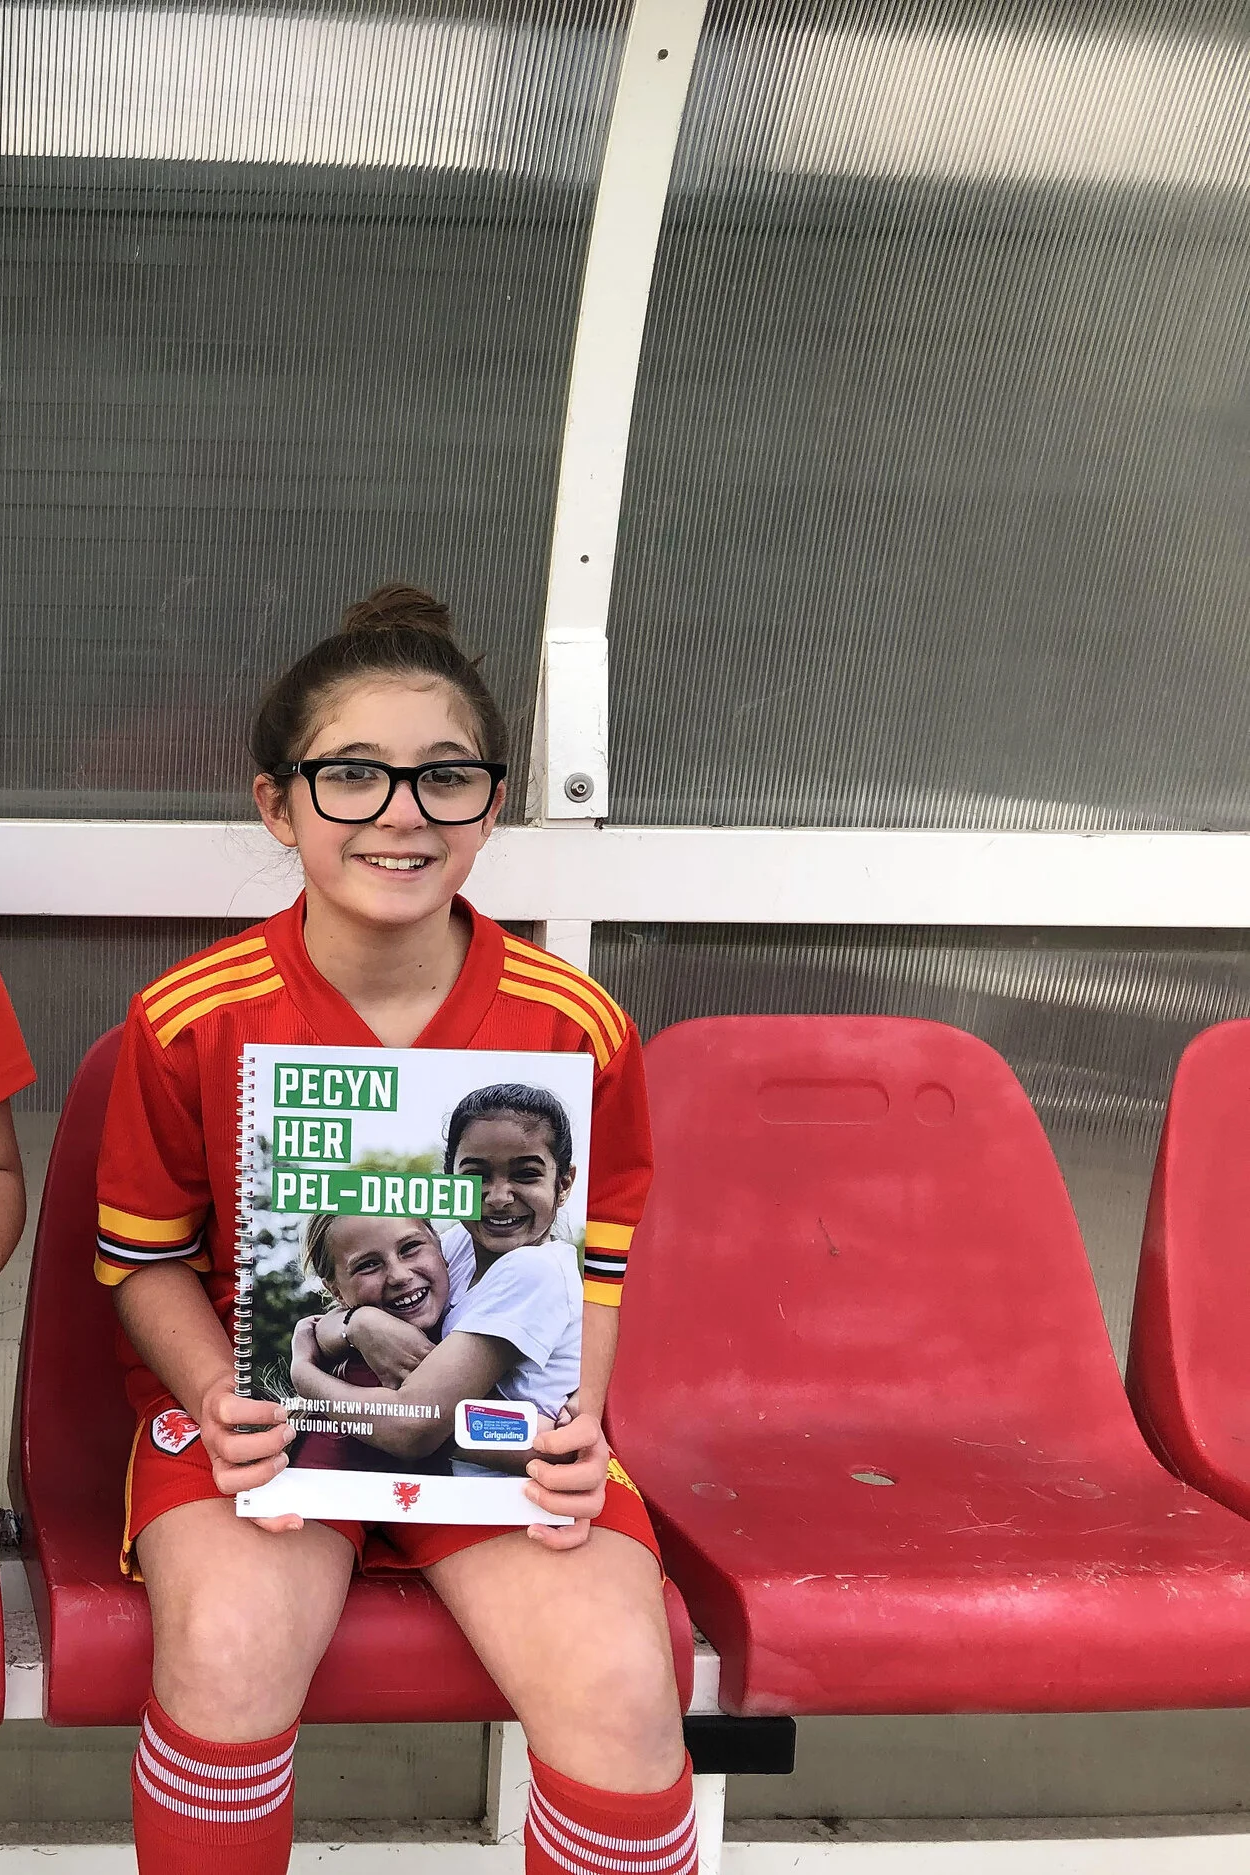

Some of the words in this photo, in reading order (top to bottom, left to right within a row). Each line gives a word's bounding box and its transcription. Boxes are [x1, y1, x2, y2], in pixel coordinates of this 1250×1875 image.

[278, 1067, 394, 1108] PECYN
[277, 1120, 344, 1159] HER
[276, 1172, 474, 1217] PEL-DROED
[302, 1399, 331, 1413] TRUST
[333, 1400, 362, 1416] MEWN
[364, 1402, 432, 1419] PARTNERIAETH
[341, 1421, 374, 1436] CYMRU
[483, 1430, 524, 1441] Girlguiding
